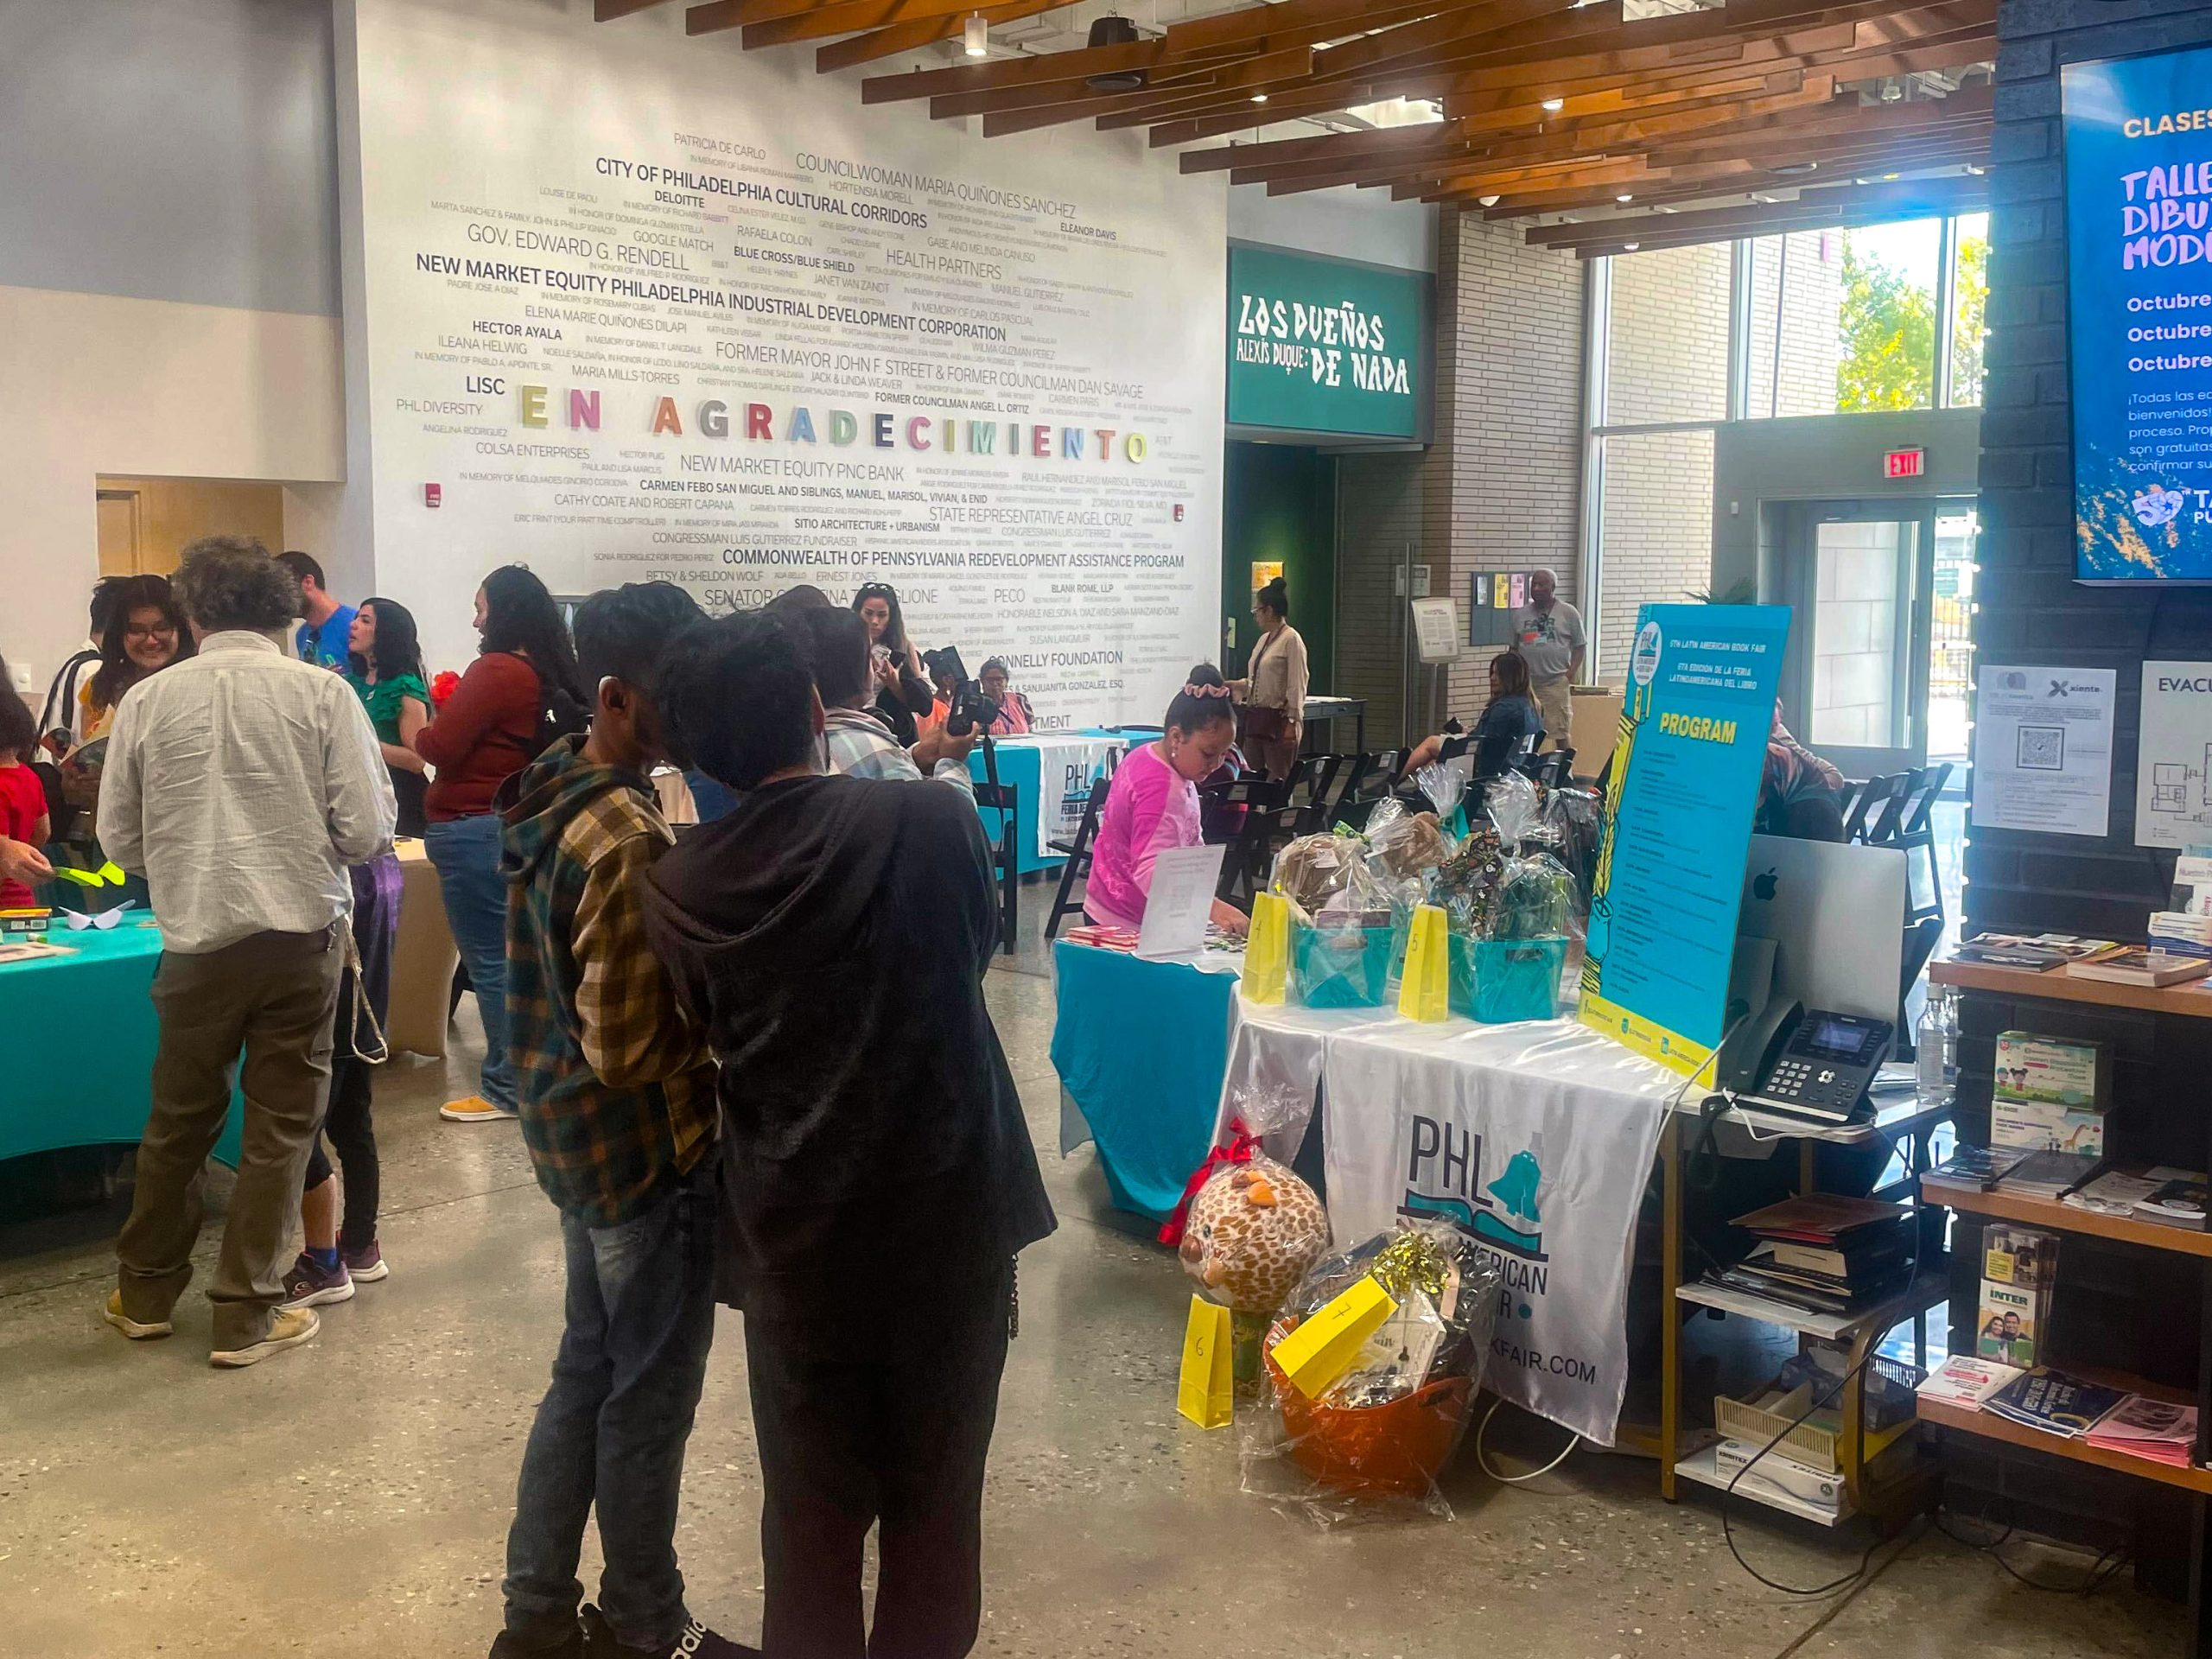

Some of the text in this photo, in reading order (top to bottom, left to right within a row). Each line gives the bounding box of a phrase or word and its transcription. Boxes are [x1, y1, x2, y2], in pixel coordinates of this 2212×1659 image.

[674, 133, 766, 160] PATRICIA DE CARLO
[596, 157, 632, 178] CITY
[637, 164, 658, 182] OF
[663, 169, 772, 201] PHILADELPHIA
[776, 188, 848, 216] CULTURAL
[851, 203, 928, 228] CORRIDORS
[797, 152, 912, 189] COUNCILWOMAN
[915, 175, 956, 195] MARIA
[957, 184, 1021, 209] QUIÑONES
[1023, 196, 1077, 219] SANCHEZ
[655, 190, 705, 208] DELOITTE
[2122, 198, 2212, 237] DIBU
[633, 230, 714, 251] GOOGLE MATCH
[1060, 223, 1116, 240] ELEANOR DAVIS
[467, 223, 690, 271] GOV. EDWARD G. RENDELL
[734, 246, 855, 273] BLUE CROSS/BLUE SHIELD
[887, 249, 936, 271] HEALTH
[938, 256, 1001, 279] PARTNERS
[416, 253, 460, 275] NEW
[467, 259, 541, 285] MARKET
[546, 270, 607, 293] EQUITY
[612, 278, 725, 308] PHILADELPHIA
[729, 293, 814, 319] INDUSTRIAL
[817, 305, 916, 331] DEVELOPMENT
[918, 318, 1006, 342] CORPORATION
[2127, 294, 2212, 312] Octubre
[525, 306, 560, 320] ELENA
[563, 310, 596, 324] MARIE
[599, 312, 653, 330] QUIÑONES
[1238, 296, 1384, 351] LOS DUEÑOS
[473, 321, 562, 340] HECTOR AYALA
[2127, 323, 2212, 342] Octubre
[439, 335, 527, 354] ILEANA HELWIG
[572, 365, 606, 379] MARIA
[716, 342, 778, 363] FORMER
[781, 349, 830, 368] MAYOR
[835, 354, 870, 373] JOHN
[886, 359, 933, 378] STREET
[936, 365, 944, 379] &
[947, 366, 997, 385] FORMER
[1000, 372, 1077, 392] COUNCILMAN
[1078, 380, 1102, 395] DAN
[1103, 382, 1143, 399] SAVAGE
[1310, 347, 1410, 395] DE NADA
[2128, 354, 2212, 372] Octubre
[467, 376, 505, 395] LISC
[875, 392, 911, 404] FORMER
[912, 396, 968, 410] COUNCILMAN
[970, 400, 995, 411] ANGEL
[998, 403, 1004, 412] L.
[1007, 403, 1029, 415] ORTIZ
[2176, 391, 2195, 401] las
[397, 399, 483, 415] PHL DIVERSITY
[521, 385, 1147, 464] EN AGRADECIMIENTO
[2129, 427, 2184, 440] proceso.
[476, 442, 589, 460] COLSA ENTERPRISES
[2129, 446, 2152, 454] son
[681, 455, 904, 481] NEW MARKET EQUITY PNC BANK
[1891, 453, 1918, 475] EXIT
[2129, 461, 2193, 472] confirmar
[639, 480, 684, 493] CARMEN
[688, 482, 714, 493] FEBO
[717, 482, 736, 494] SAN
[740, 484, 775, 496] MIGUEL
[778, 486, 798, 496] AND
[801, 487, 843, 499] SIBLINGS,
[847, 489, 885, 501] MANUEL,
[888, 491, 927, 503] MARISOL,
[930, 493, 959, 505] VIVIAN,
[962, 493, 967, 502] &
[969, 494, 987, 503] ENID
[795, 518, 817, 529] SITIO
[821, 519, 887, 531] ARCHITECTURE
[896, 522, 940, 532] URBANISM
[930, 506, 1133, 525] STATE REPRESENTATIVE ANGEL CRUZ
[723, 550, 1184, 568] COMMONWEALTH OF PENNSYLVANIA REDEVELOPMENT ASSISTANCE PROGRAM
[705, 588, 772, 606] SENATOR
[849, 589, 938, 604] TGLIONE
[995, 589, 1025, 603] PECO
[1051, 651, 1123, 667] FOUNDATION
[1659, 712, 1738, 745] PROGRAM
[1065, 764, 1090, 790] PHL
[1409, 1115, 1493, 1208] PHL
[1990, 1288, 2029, 1306] INTER
